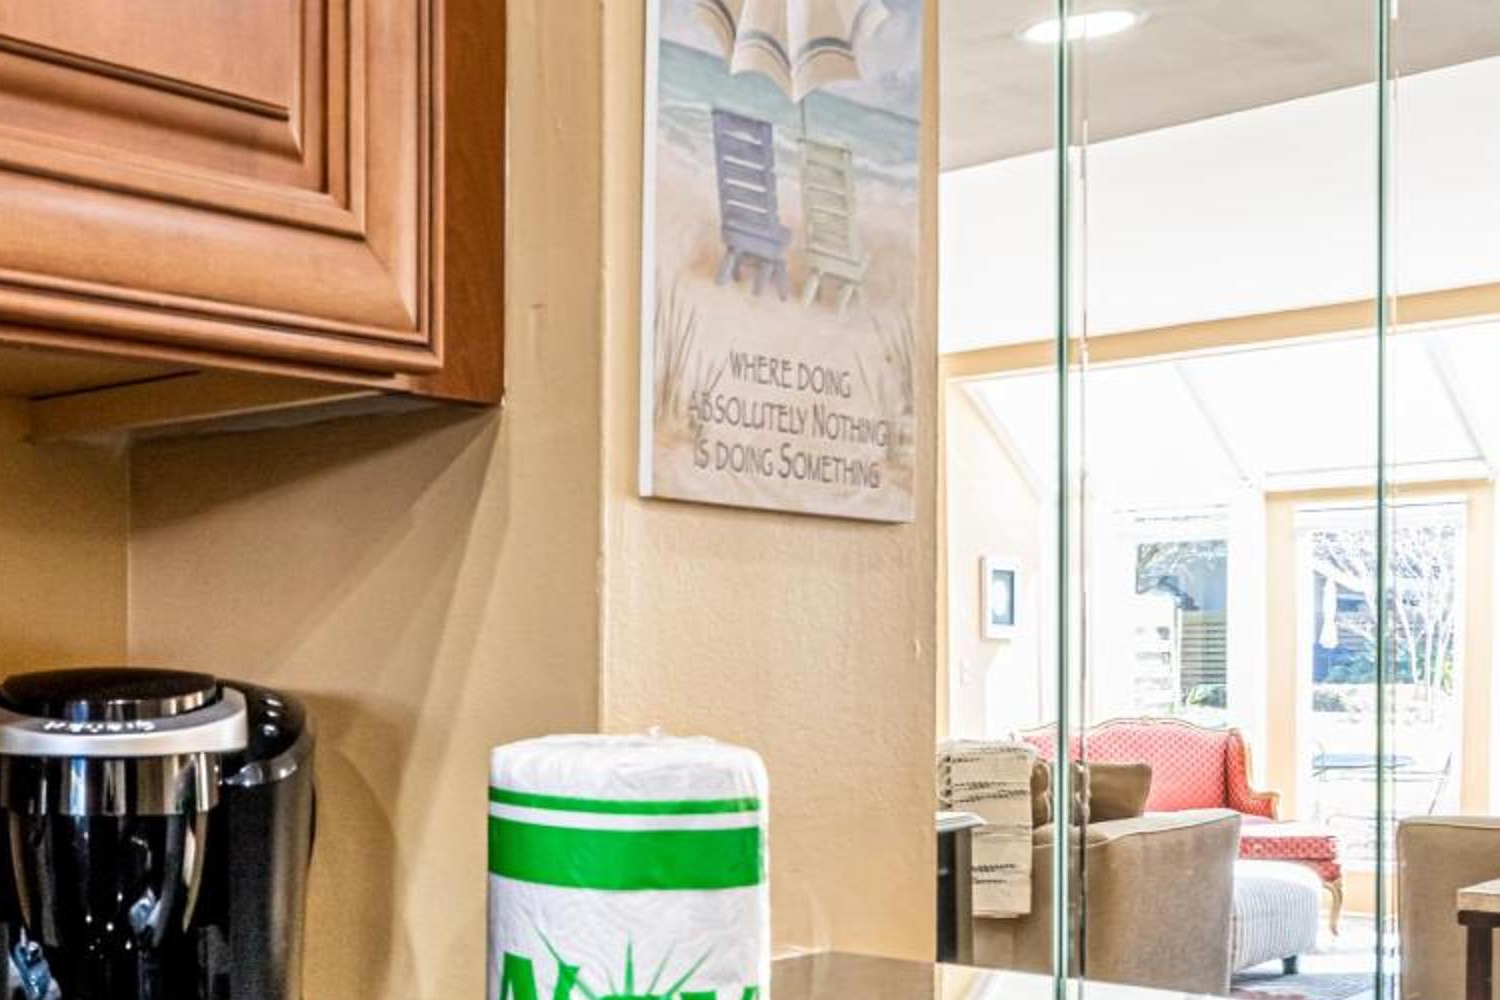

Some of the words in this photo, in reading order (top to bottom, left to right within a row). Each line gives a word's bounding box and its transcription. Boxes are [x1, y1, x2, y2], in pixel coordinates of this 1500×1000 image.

[729, 350, 792, 389] WHERE
[797, 362, 851, 399] DOING
[688, 389, 809, 435] ABSOLUTELY
[812, 402, 888, 448] NOTHING
[715, 441, 774, 477] DOING
[777, 443, 881, 488] SOMETHING
